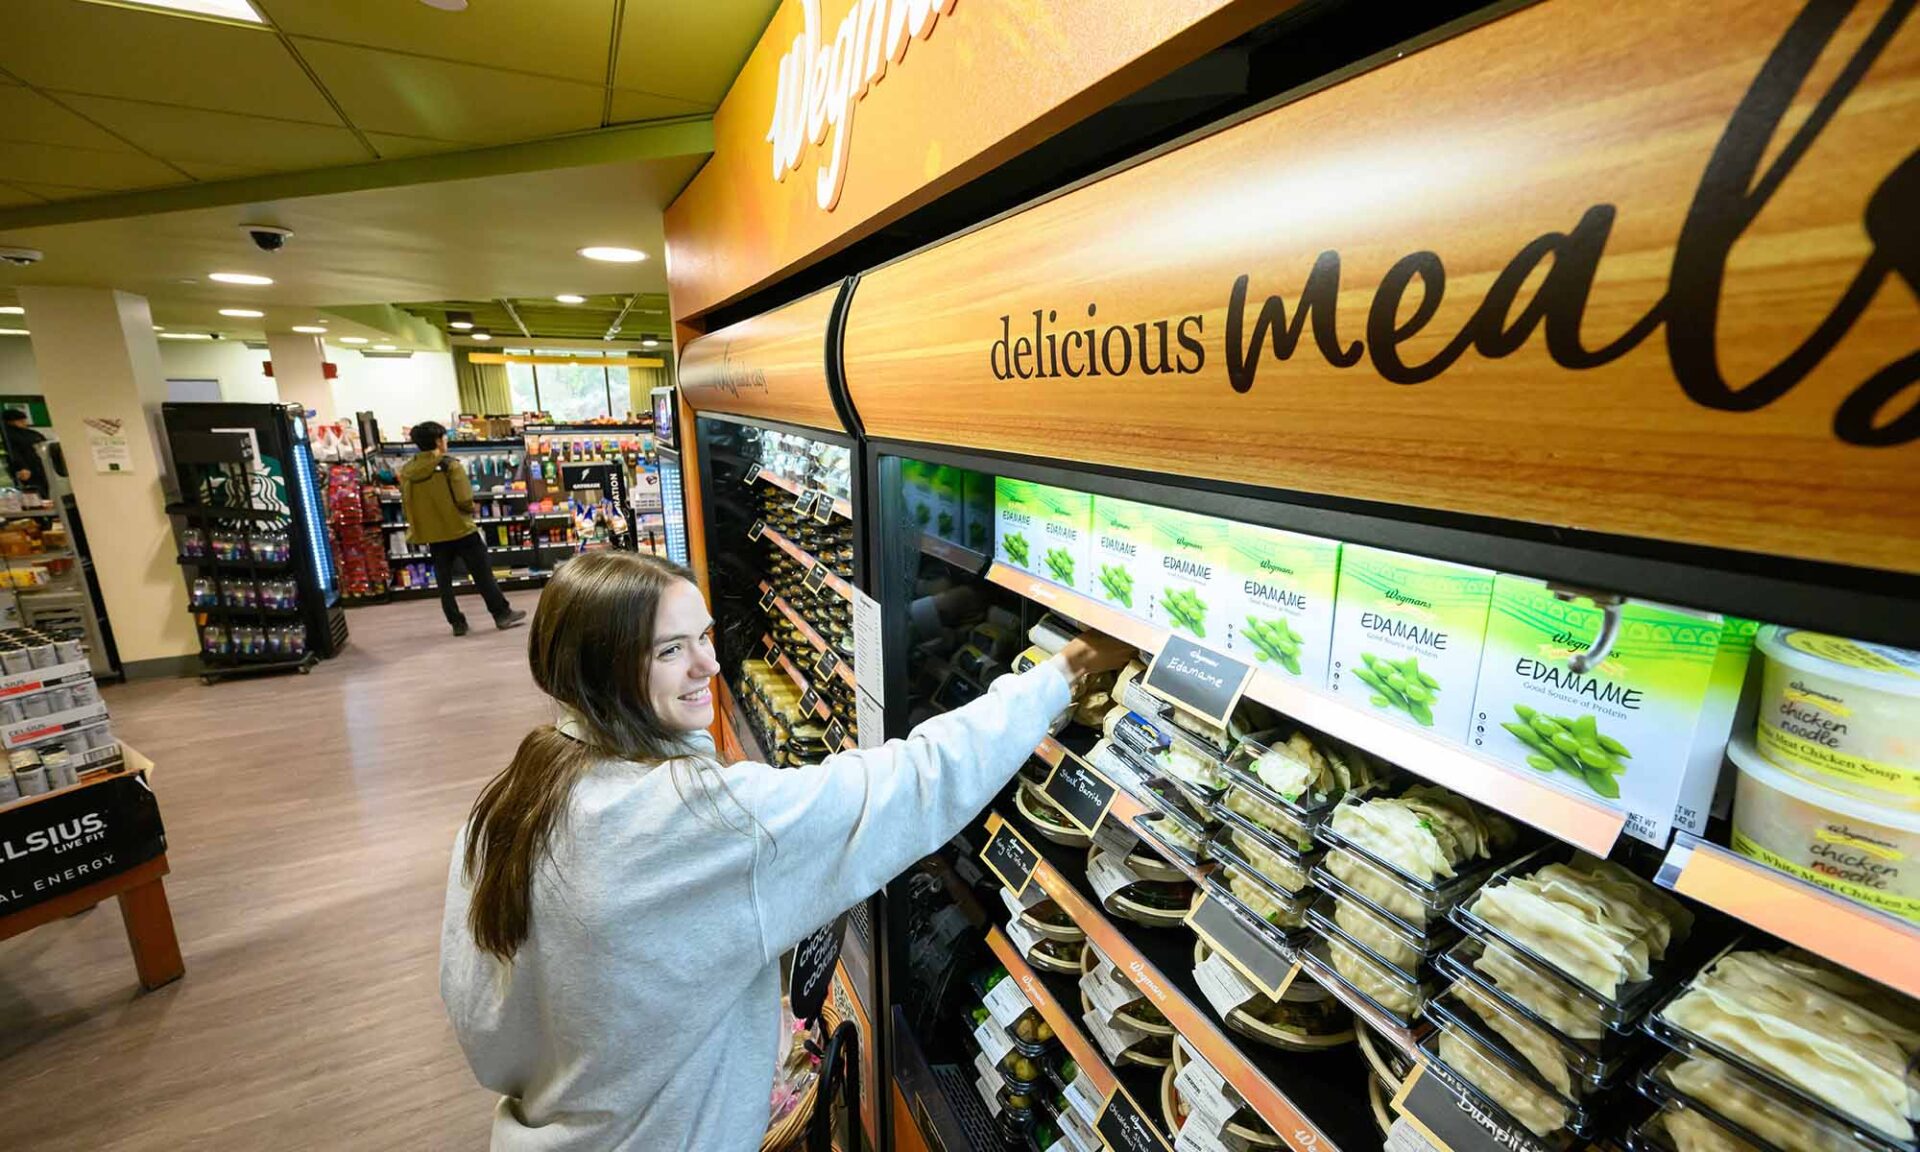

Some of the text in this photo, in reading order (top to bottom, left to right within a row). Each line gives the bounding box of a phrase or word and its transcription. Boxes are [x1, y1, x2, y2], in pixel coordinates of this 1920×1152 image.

[766, 0, 942, 210] Wegm
[989, 303, 1205, 381] delicious
[1163, 556, 1212, 580] EDAMAME
[1260, 559, 1294, 575] Wegmans
[1244, 580, 1307, 610] EDAMAME
[1384, 588, 1432, 609] Wegmans
[1360, 612, 1449, 650] EDAMAME
[1167, 657, 1224, 688] Edamame
[1516, 657, 1644, 710] EDAMAME
[1523, 681, 1628, 720] Good Source of Protein
[1779, 701, 1848, 735] chicken
[1781, 720, 1840, 749] noodle
[1800, 744, 1856, 769] Chicken
[1860, 762, 1902, 781] Soup
[1079, 782, 1102, 807] Burrito
[1627, 812, 1657, 829] NET WT
[1684, 808, 1697, 818] WT
[54, 830, 105, 854] LIVE FIT
[33, 854, 116, 892] ENERGY
[1809, 843, 1899, 877] chicken
[1810, 860, 1889, 891] noodle
[1762, 852, 1799, 876] White
[1801, 871, 1837, 891] Meat
[1840, 886, 1903, 910] Chicken
[1129, 960, 1168, 1001] Wegmans
